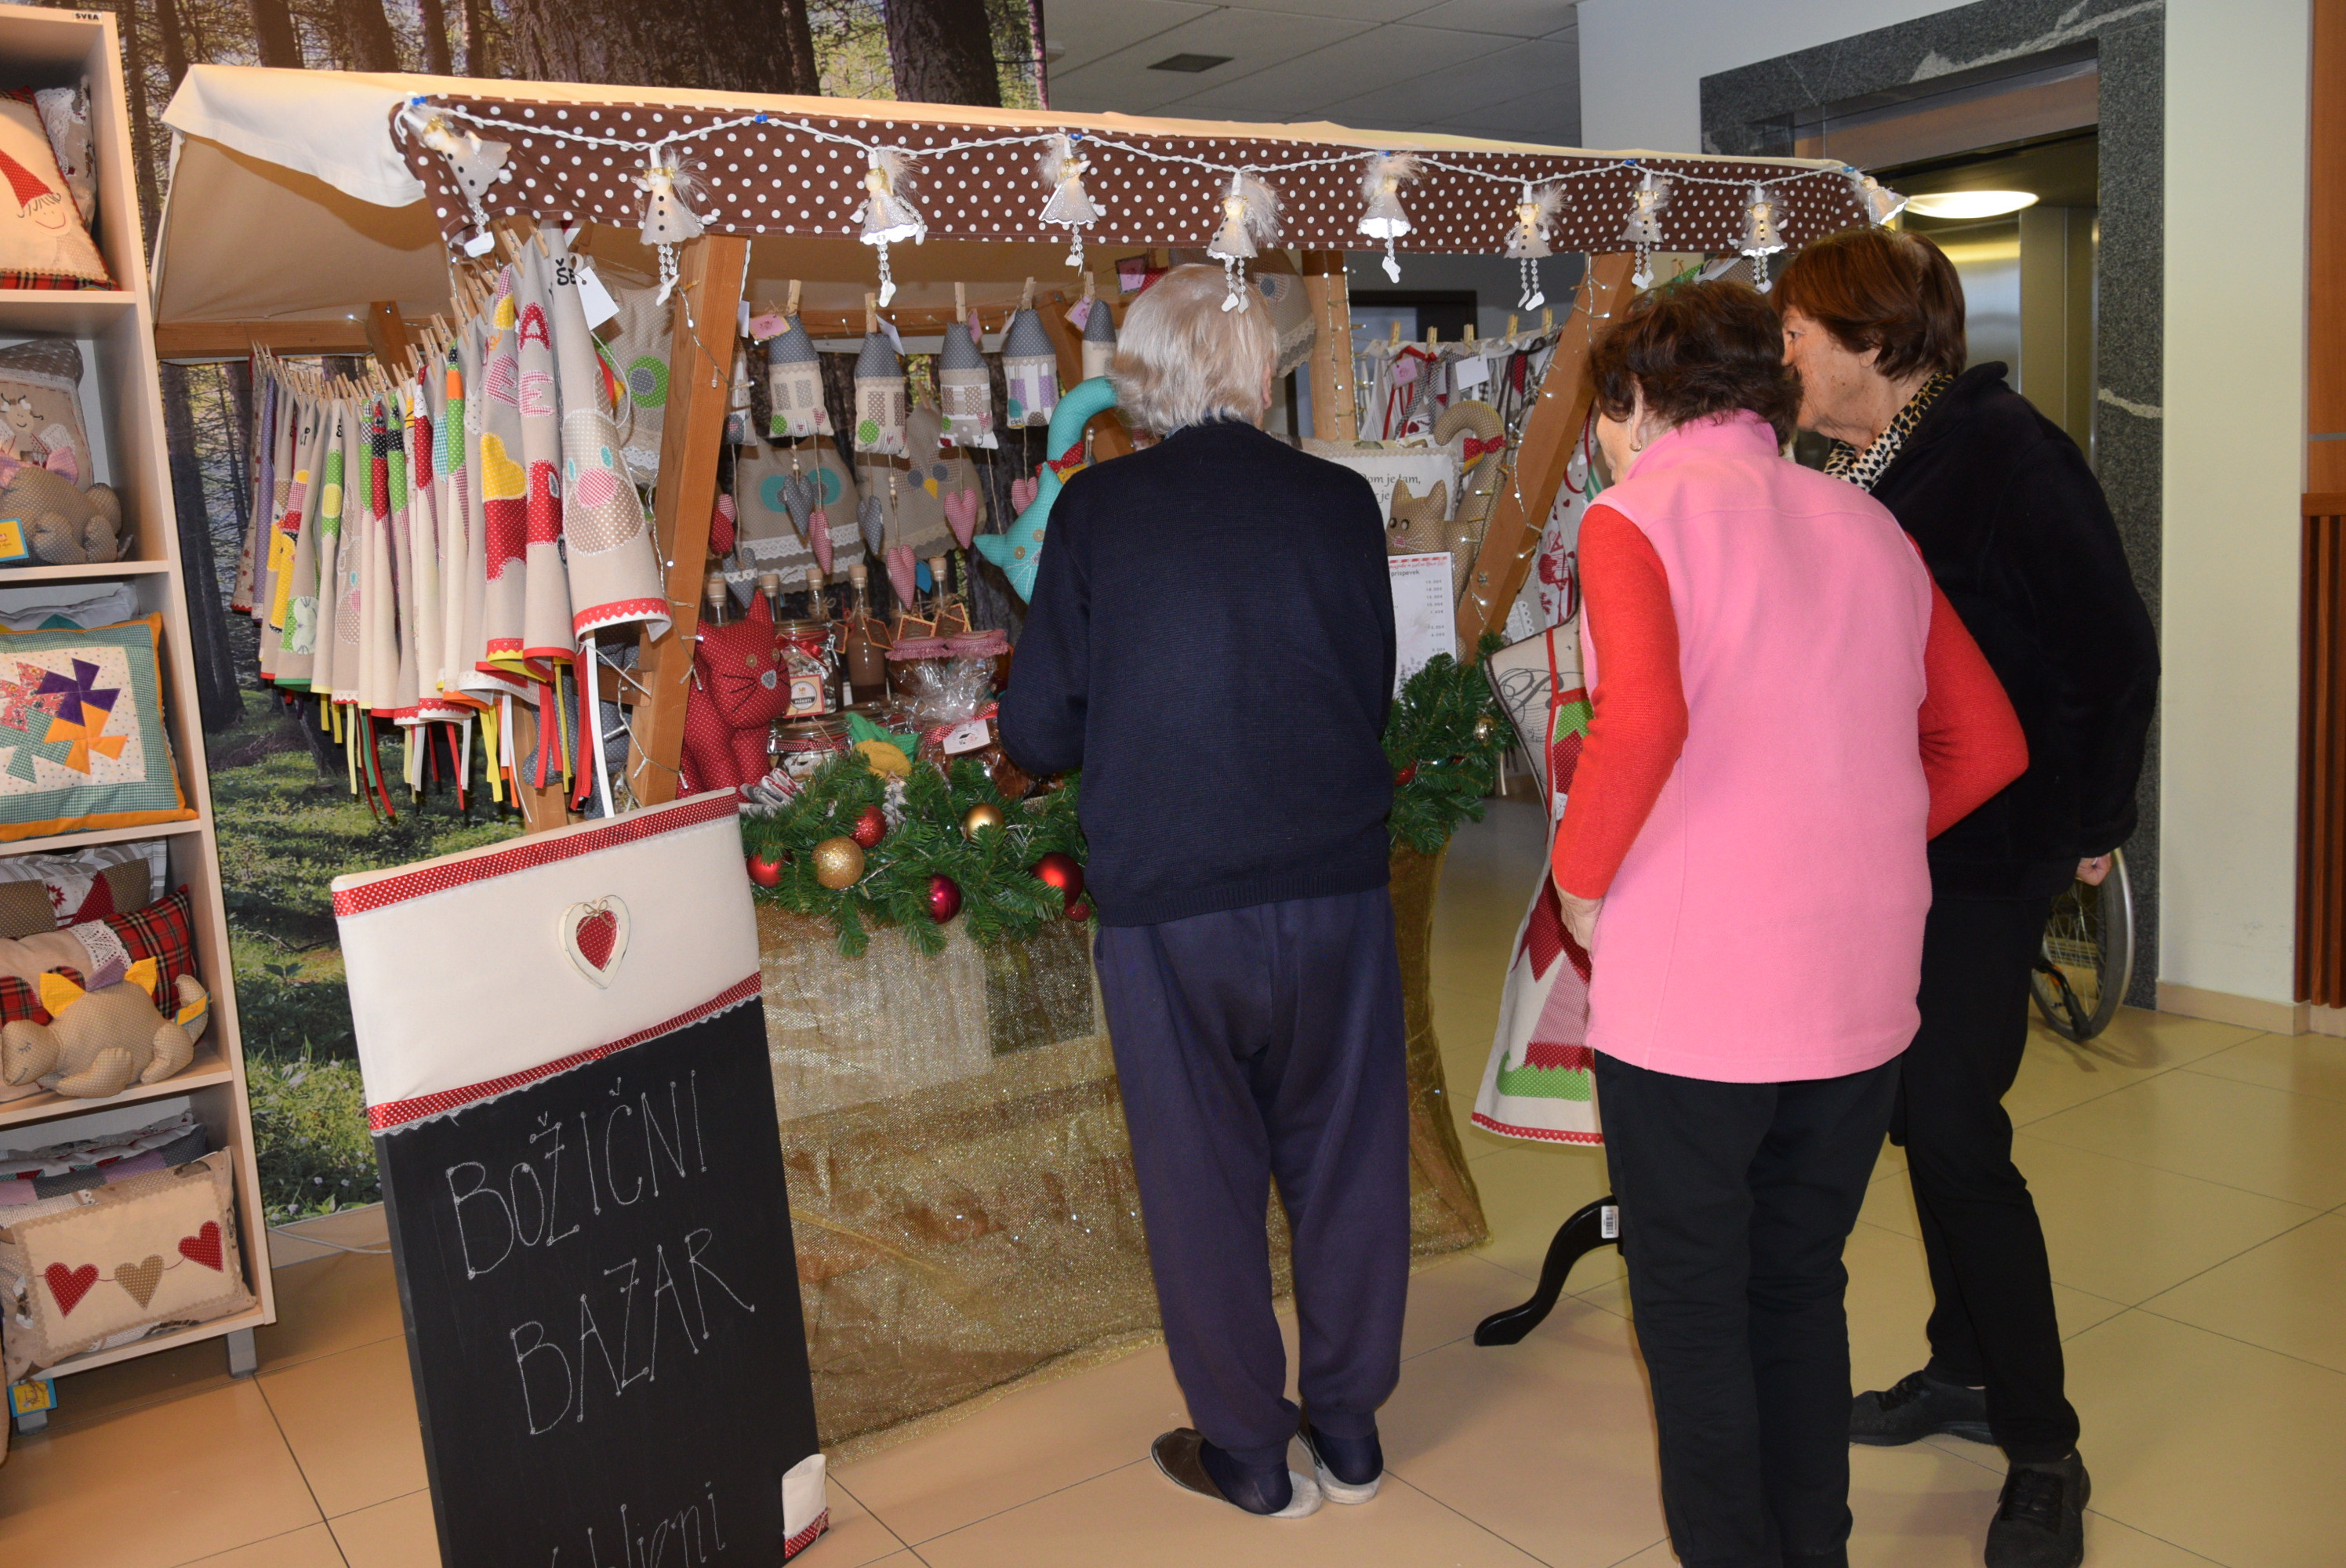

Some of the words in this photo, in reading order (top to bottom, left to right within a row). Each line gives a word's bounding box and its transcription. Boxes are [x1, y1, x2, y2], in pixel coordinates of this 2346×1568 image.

[1379, 490, 1390, 503] je
[1384, 473, 1396, 487] je
[445, 1069, 708, 1281] BOŽIČNI
[510, 1228, 757, 1436] BAZAR
